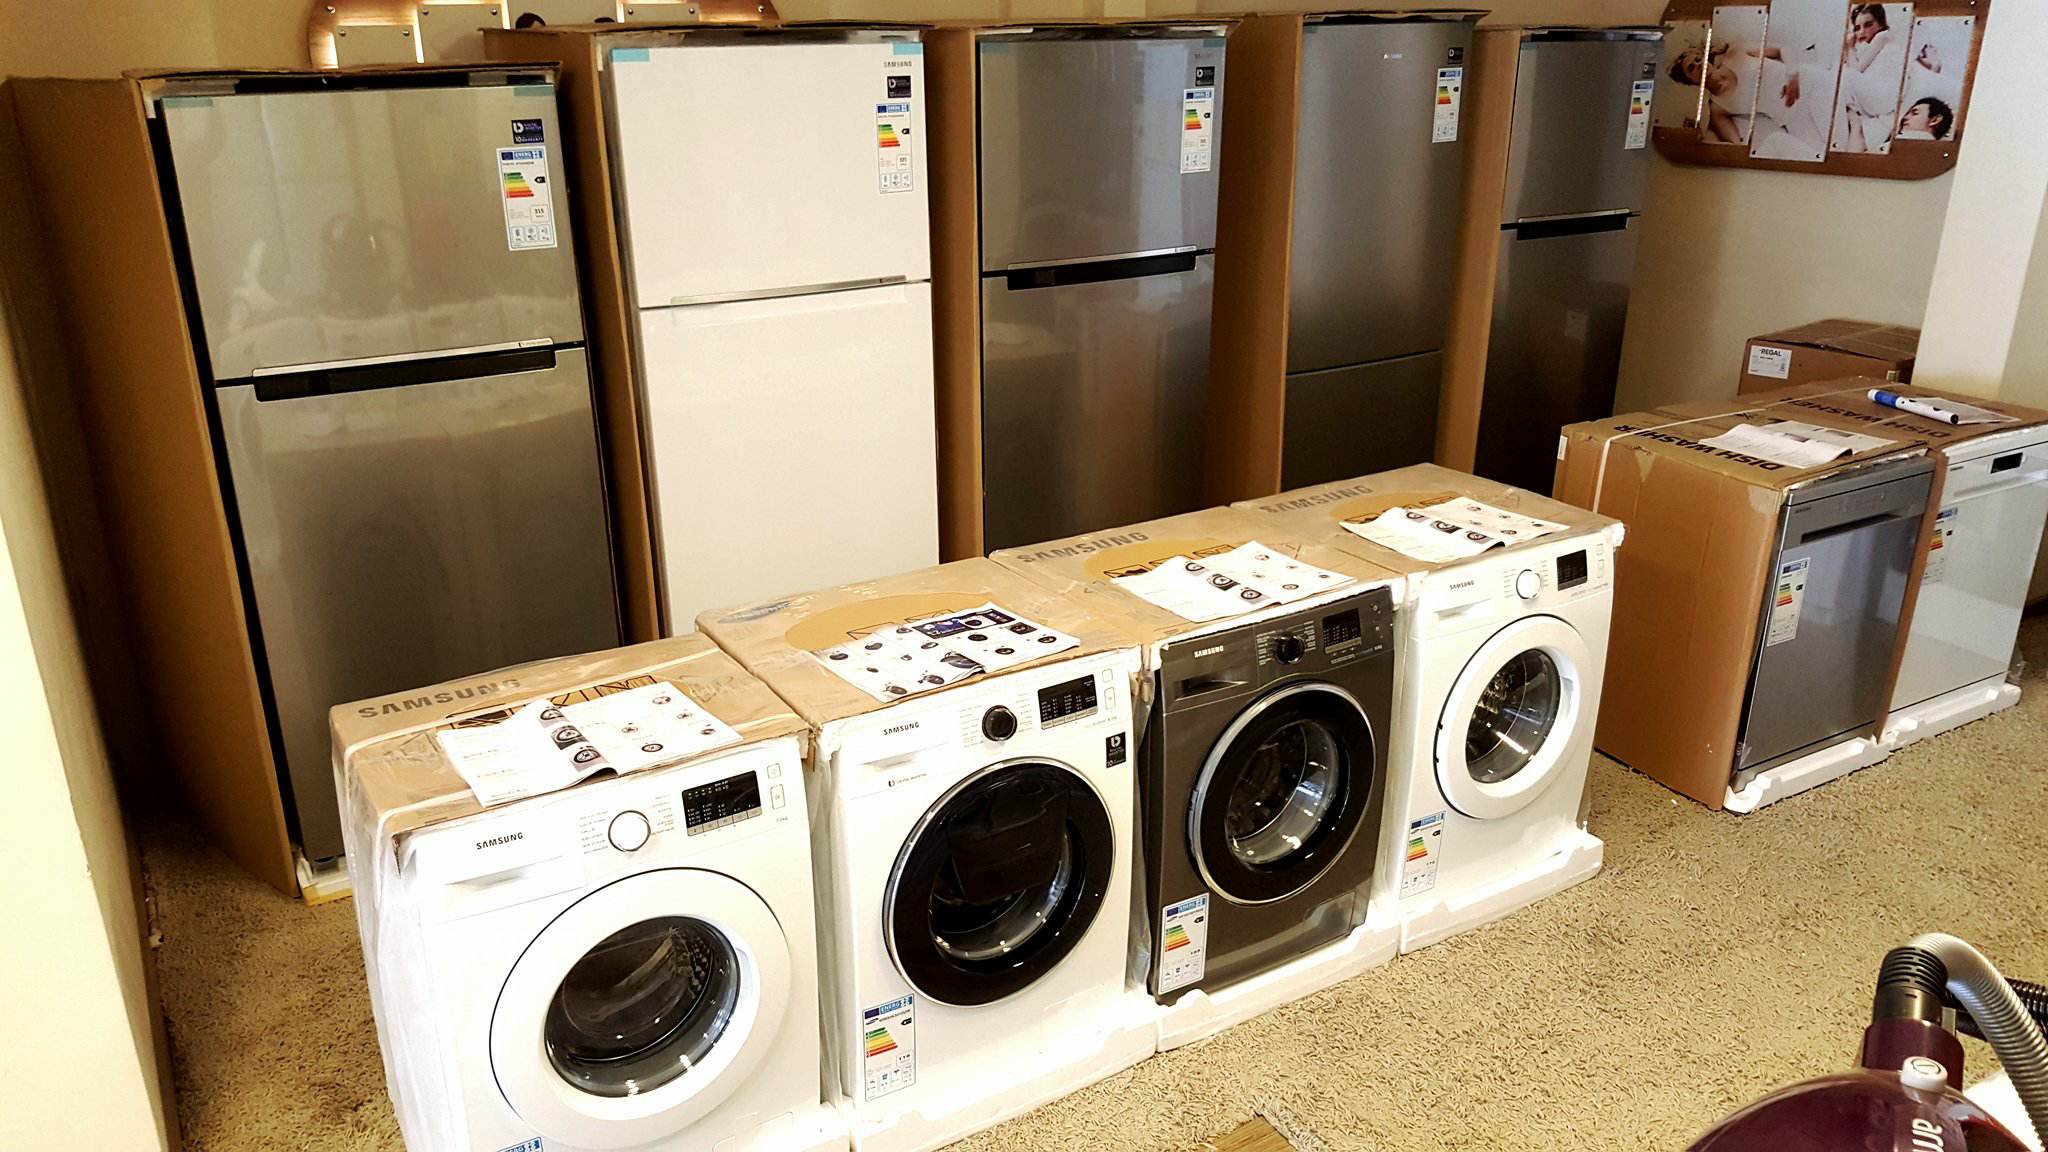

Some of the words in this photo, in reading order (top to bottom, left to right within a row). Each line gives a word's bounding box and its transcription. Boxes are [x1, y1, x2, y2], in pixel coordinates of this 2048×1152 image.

[1884, 421, 1951, 438] DISH
[1715, 451, 1785, 471] DISH
[1259, 484, 1374, 513] SAMSUNG
[1017, 532, 1149, 563] SAMSUNG
[1194, 645, 1224, 658] SAMSUNG
[358, 679, 521, 719] SAMSUNG
[884, 722, 920, 735] SAMSUNG
[476, 831, 524, 850] SAMSUNG
